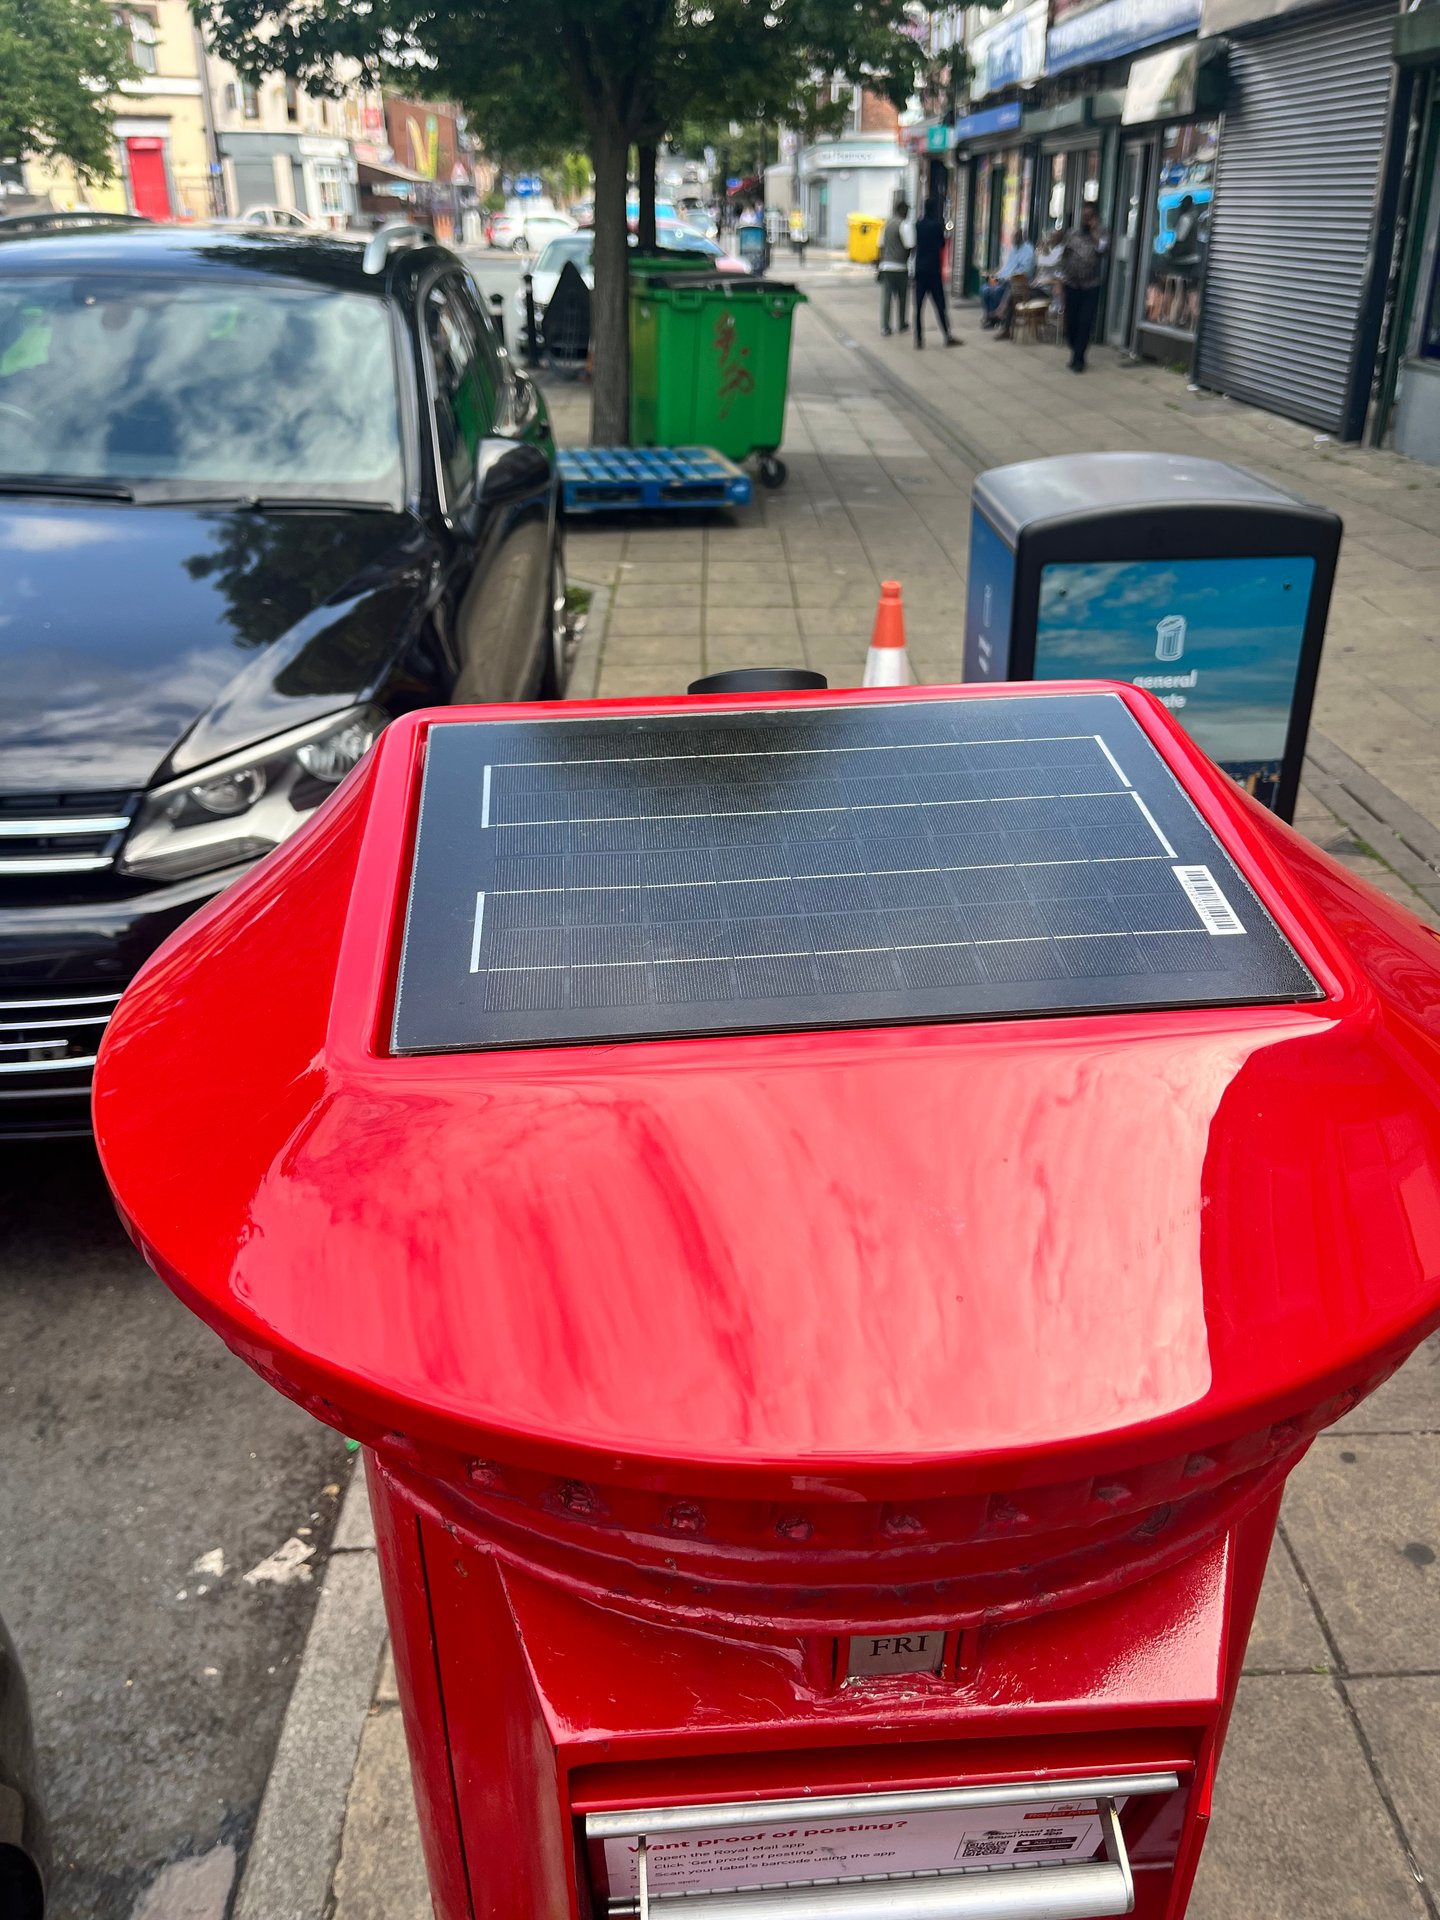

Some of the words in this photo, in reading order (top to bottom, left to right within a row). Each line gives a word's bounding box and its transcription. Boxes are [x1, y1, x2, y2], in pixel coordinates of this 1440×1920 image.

[869, 1635, 929, 1656] FRI
[697, 1833, 766, 1847] proof
[772, 1829, 798, 1838] of
[804, 1820, 908, 1837] posting?
[714, 1847, 749, 1855] Royal
[654, 1862, 684, 1870] Click
[716, 1855, 749, 1864] proof
[654, 1870, 685, 1878] Scan
[688, 1867, 717, 1875] your
[719, 1862, 758, 1871] label's
[761, 1857, 811, 1867] barcode
[814, 1855, 847, 1863] using
